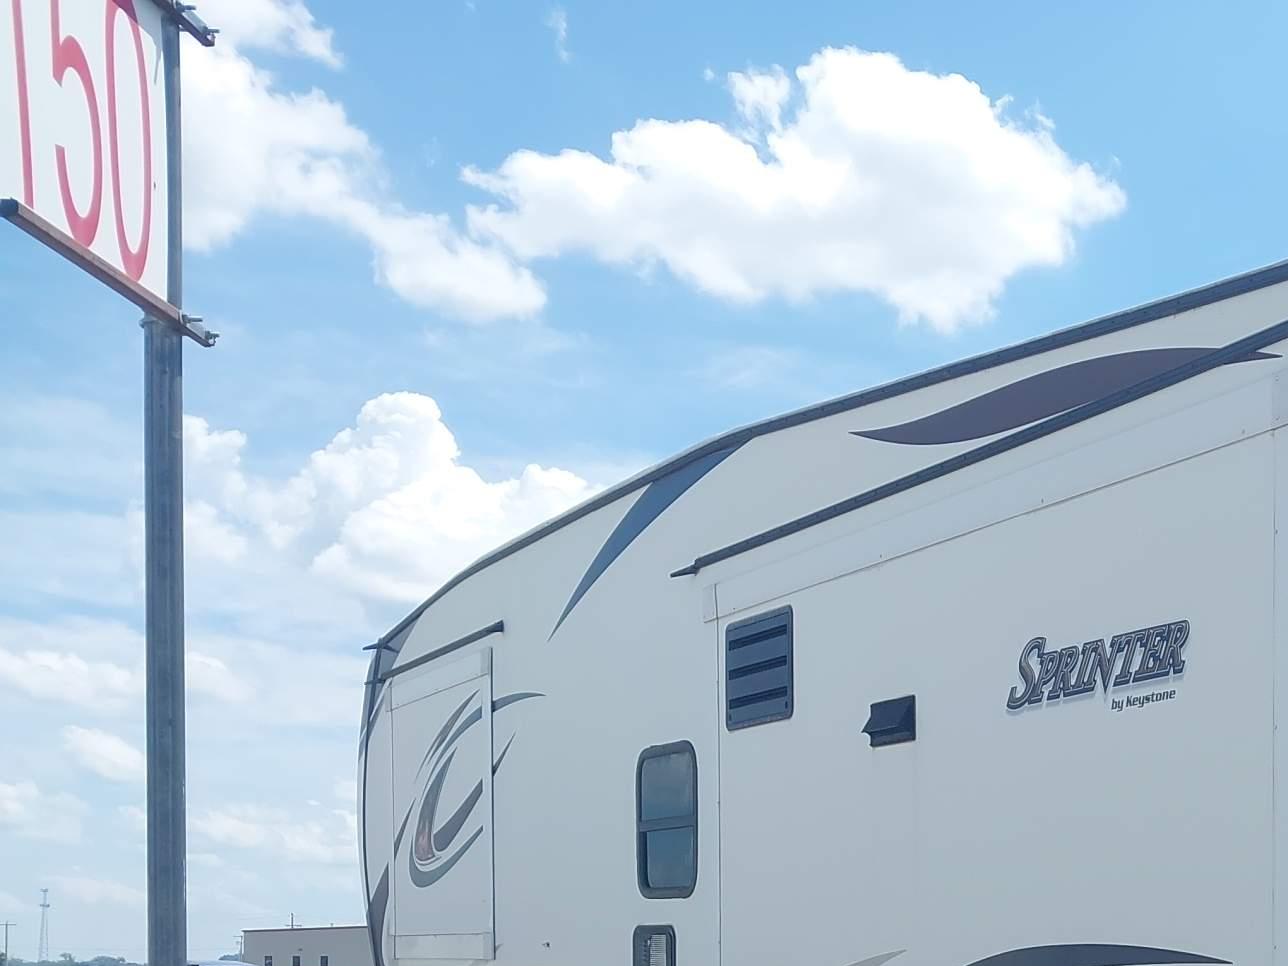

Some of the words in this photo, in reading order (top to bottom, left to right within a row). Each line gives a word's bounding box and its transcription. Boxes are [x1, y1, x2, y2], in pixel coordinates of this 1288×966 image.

[12, 0, 152, 282] 150
[1006, 619, 1190, 710] SPRINTER
[1111, 698, 1124, 712] by
[1125, 689, 1176, 708] Keystone
